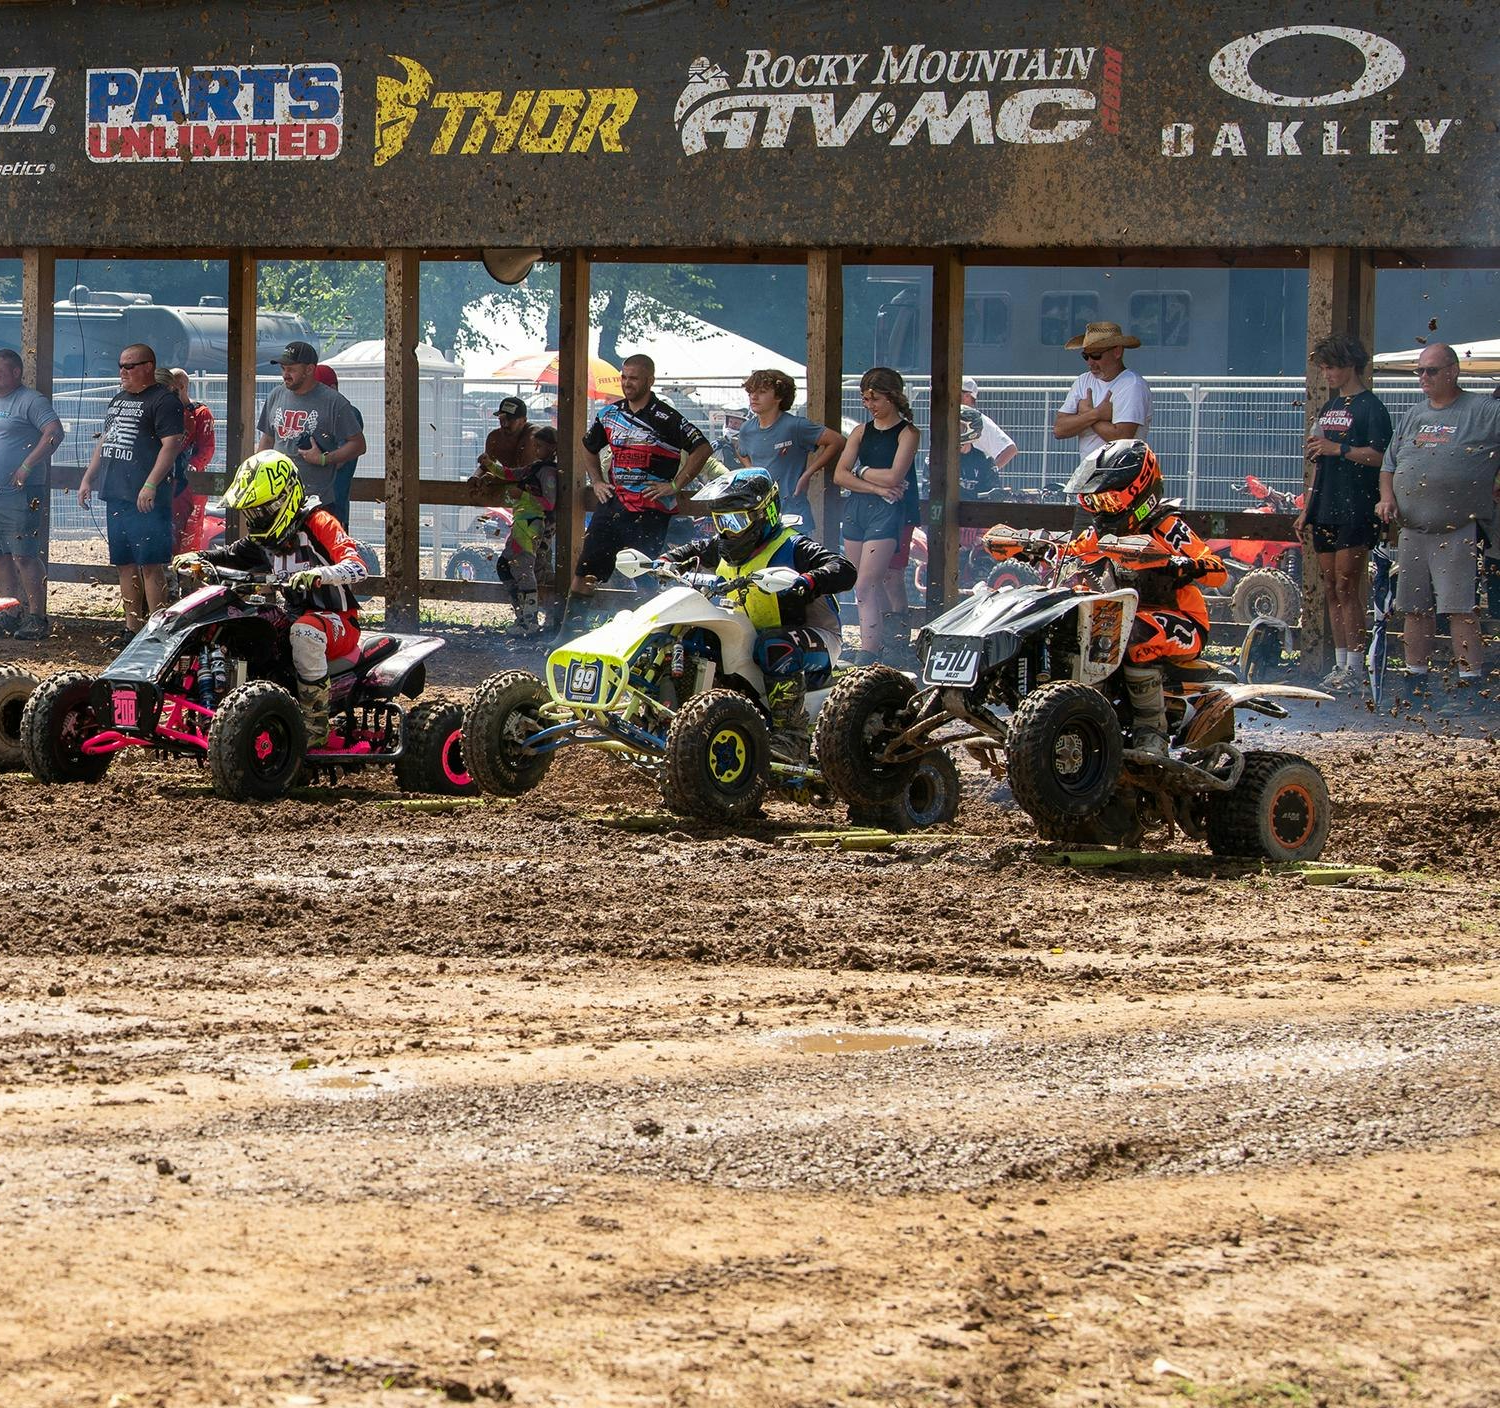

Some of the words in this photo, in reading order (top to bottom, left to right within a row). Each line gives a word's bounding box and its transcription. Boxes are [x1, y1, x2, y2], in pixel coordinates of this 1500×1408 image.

[737, 49, 868, 88] ROCKY
[872, 44, 1098, 86] MOUNTAIN
[88, 66, 341, 123] PARTS
[88, 123, 341, 158] UNLIMITED
[430, 87, 639, 155] THOR
[1162, 118, 1452, 158] OAKLEY
[102, 447, 114, 458] ME
[115, 448, 133, 461] DAD
[572, 667, 597, 690] 99
